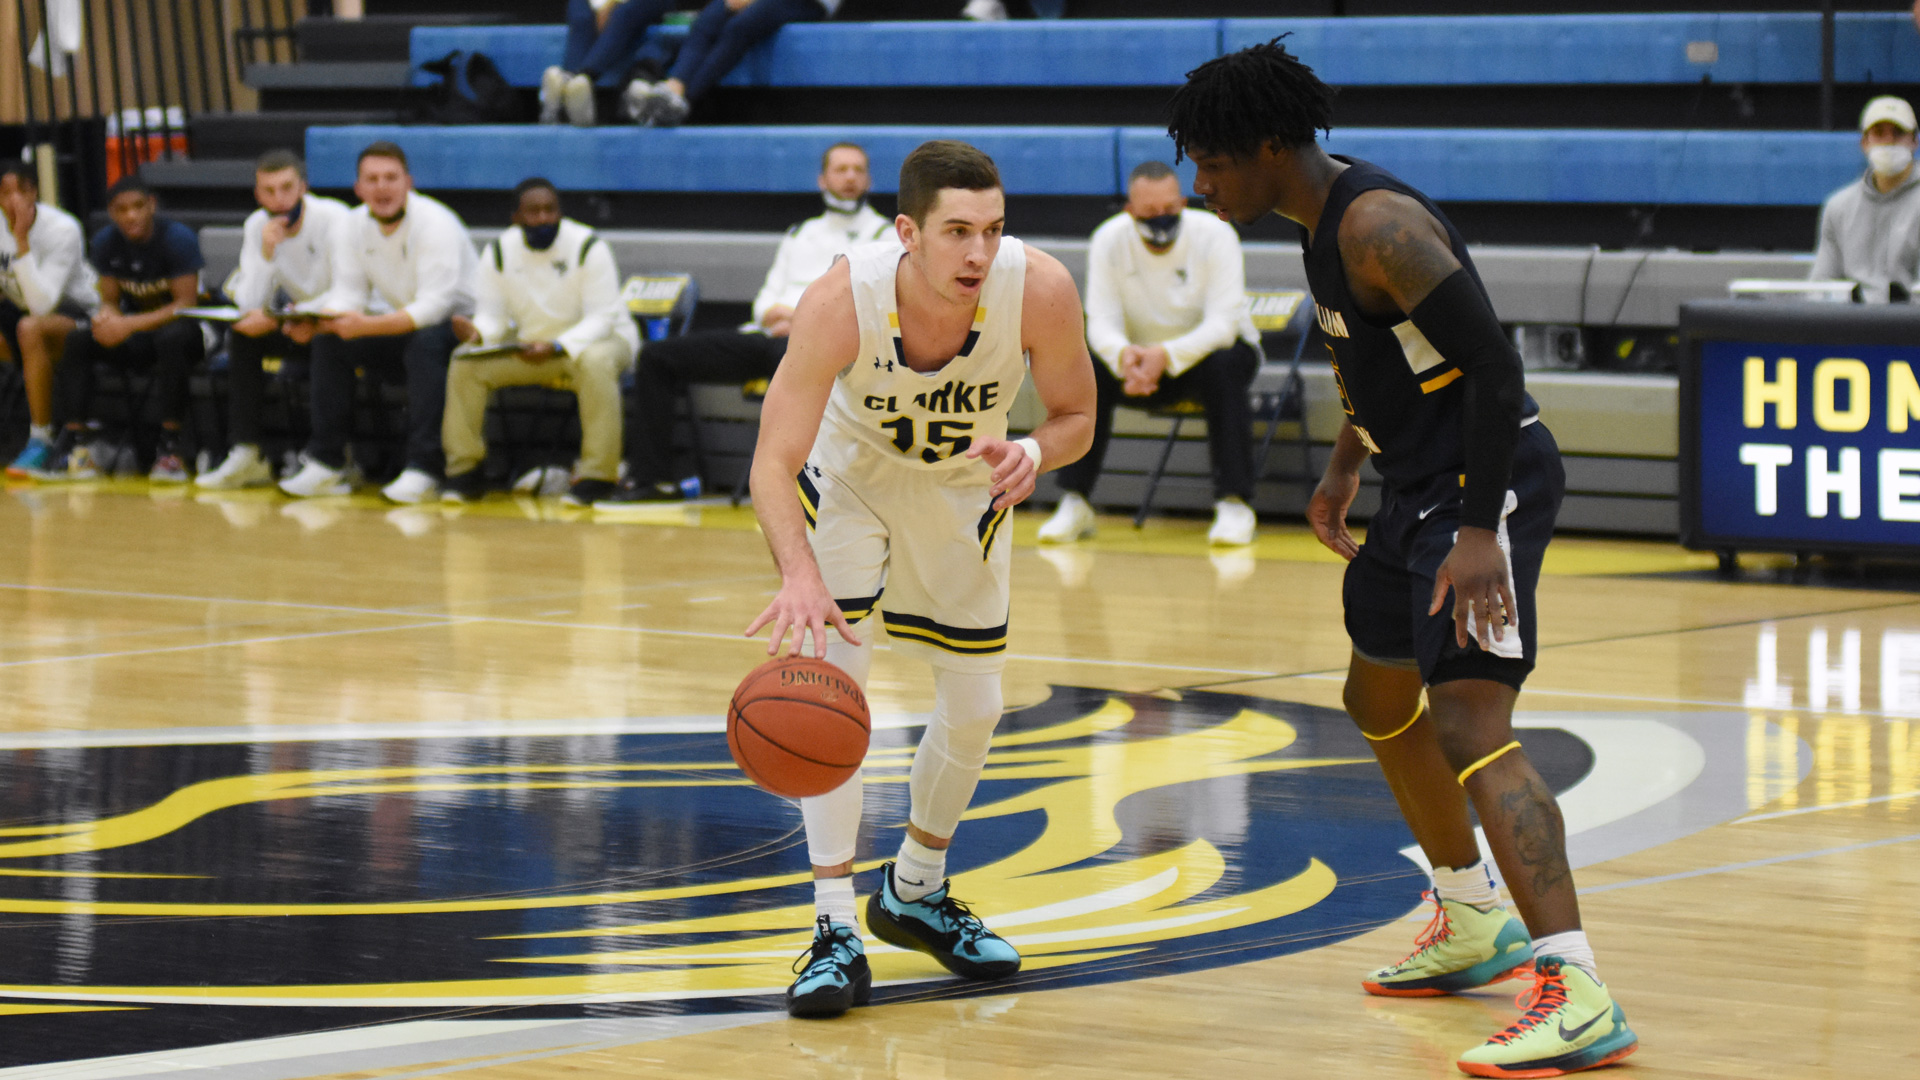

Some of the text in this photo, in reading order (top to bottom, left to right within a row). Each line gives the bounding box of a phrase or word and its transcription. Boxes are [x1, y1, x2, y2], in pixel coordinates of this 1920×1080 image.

[863, 380, 999, 413] CLARKE
[880, 414, 975, 464] 15
[1739, 443, 1920, 521] THE
